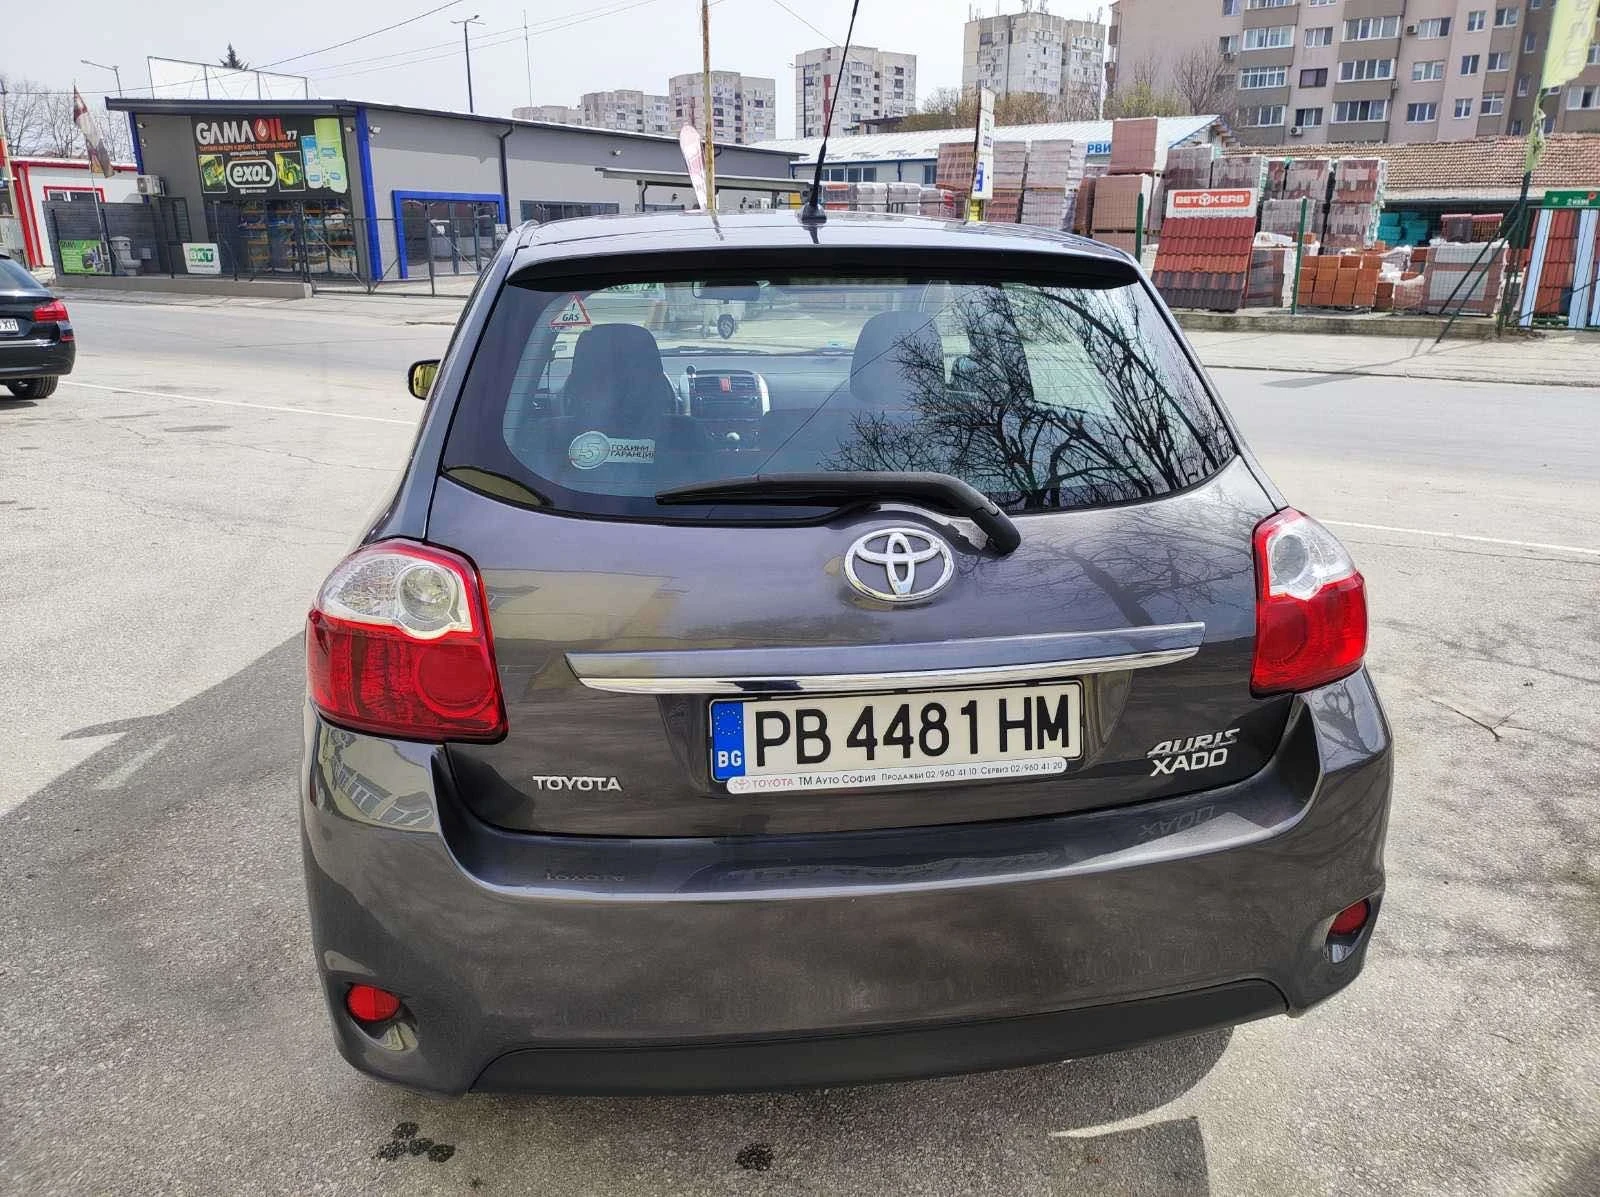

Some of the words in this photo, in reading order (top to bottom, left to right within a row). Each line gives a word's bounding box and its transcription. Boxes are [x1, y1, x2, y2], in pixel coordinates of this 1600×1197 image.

[562, 313, 579, 321] GAS
[611, 444, 649, 452] ГОДИНИ
[755, 708, 831, 767] PB
[847, 699, 978, 761] 4481
[998, 694, 1069, 752] HM
[1147, 728, 1240, 758] AURIS
[717, 751, 742, 767] BG
[1150, 748, 1228, 776] XADO
[533, 775, 622, 791] TOYOTA
[752, 778, 794, 788] TOYOTA
[968, 767, 977, 776] 10
[1053, 761, 1063, 770] 20
